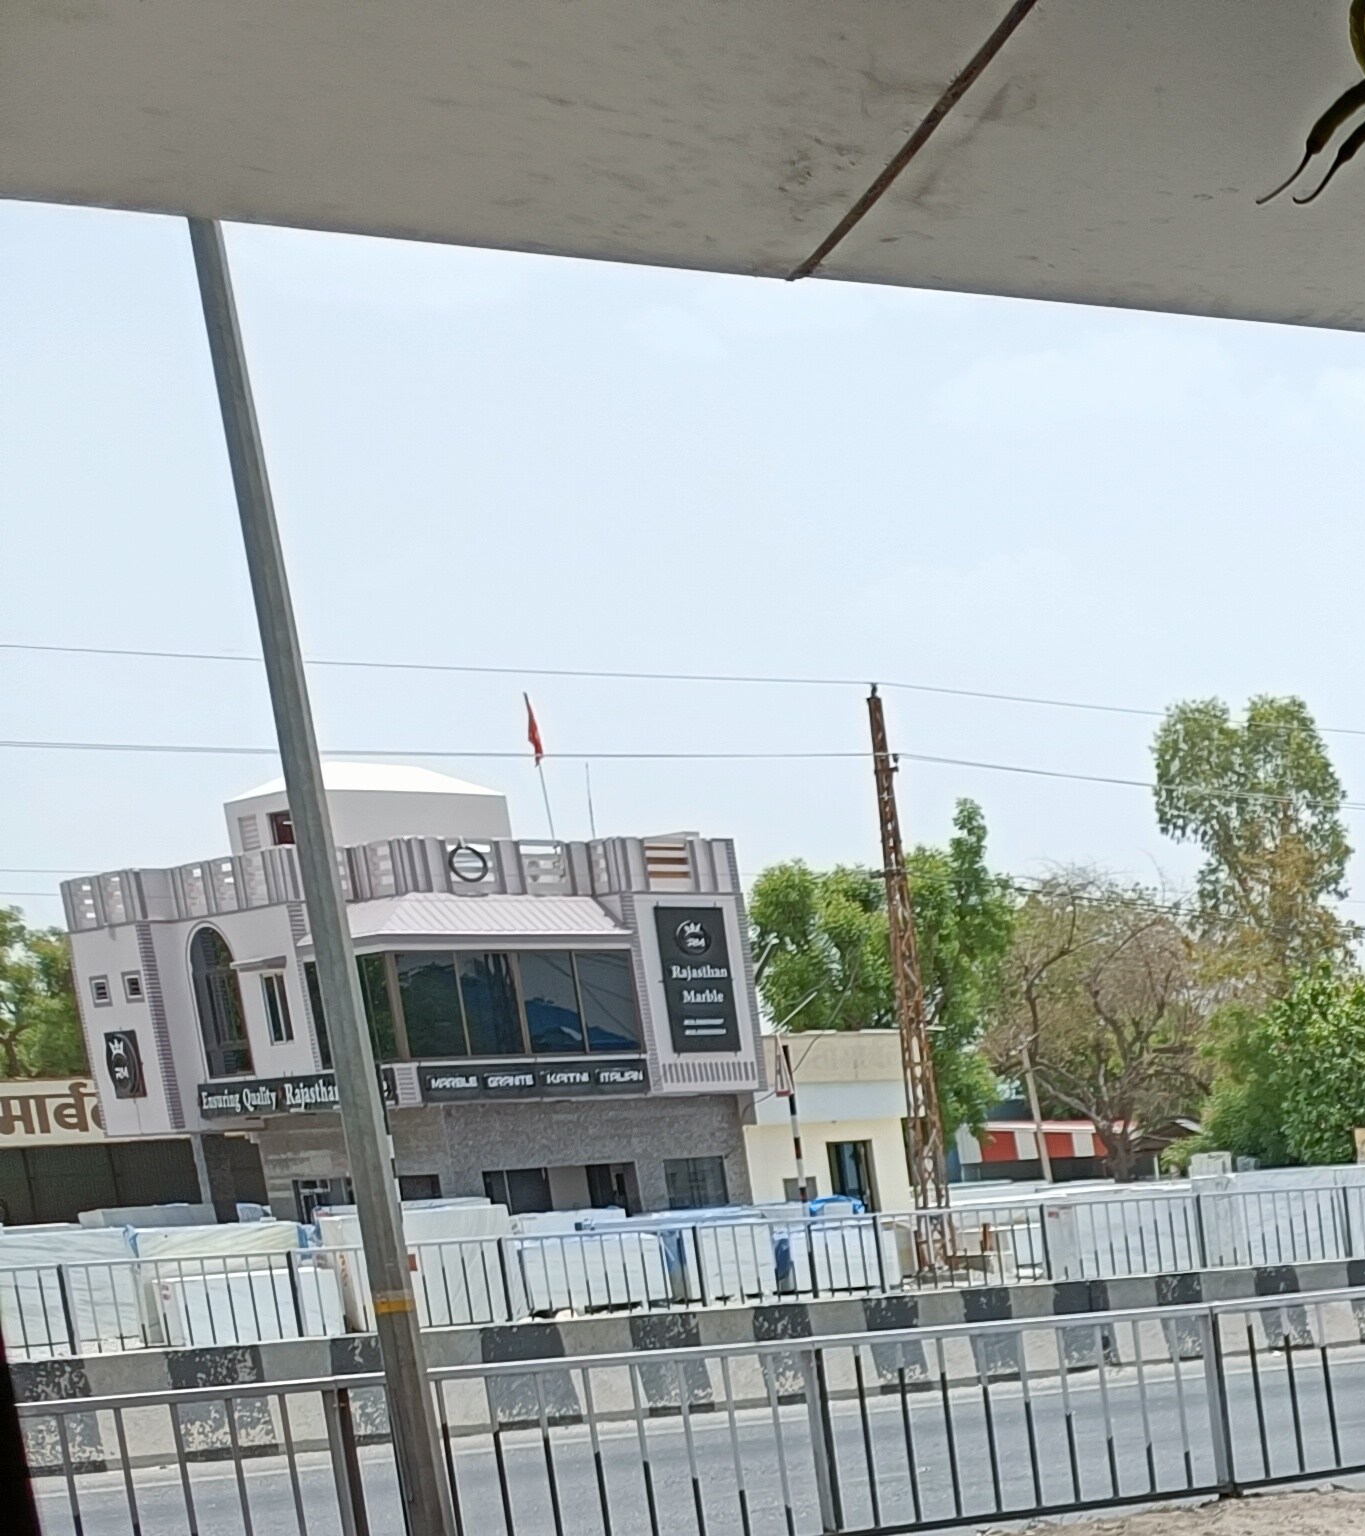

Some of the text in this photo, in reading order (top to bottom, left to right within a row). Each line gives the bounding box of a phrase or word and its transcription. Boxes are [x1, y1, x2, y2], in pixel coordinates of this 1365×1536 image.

[671, 965, 728, 981] Rajasthan
[682, 989, 724, 1003] Marble
[431, 1076, 478, 1090] MARBLE
[201, 1088, 241, 1112] Ensuring
[242, 1086, 277, 1113] Quality
